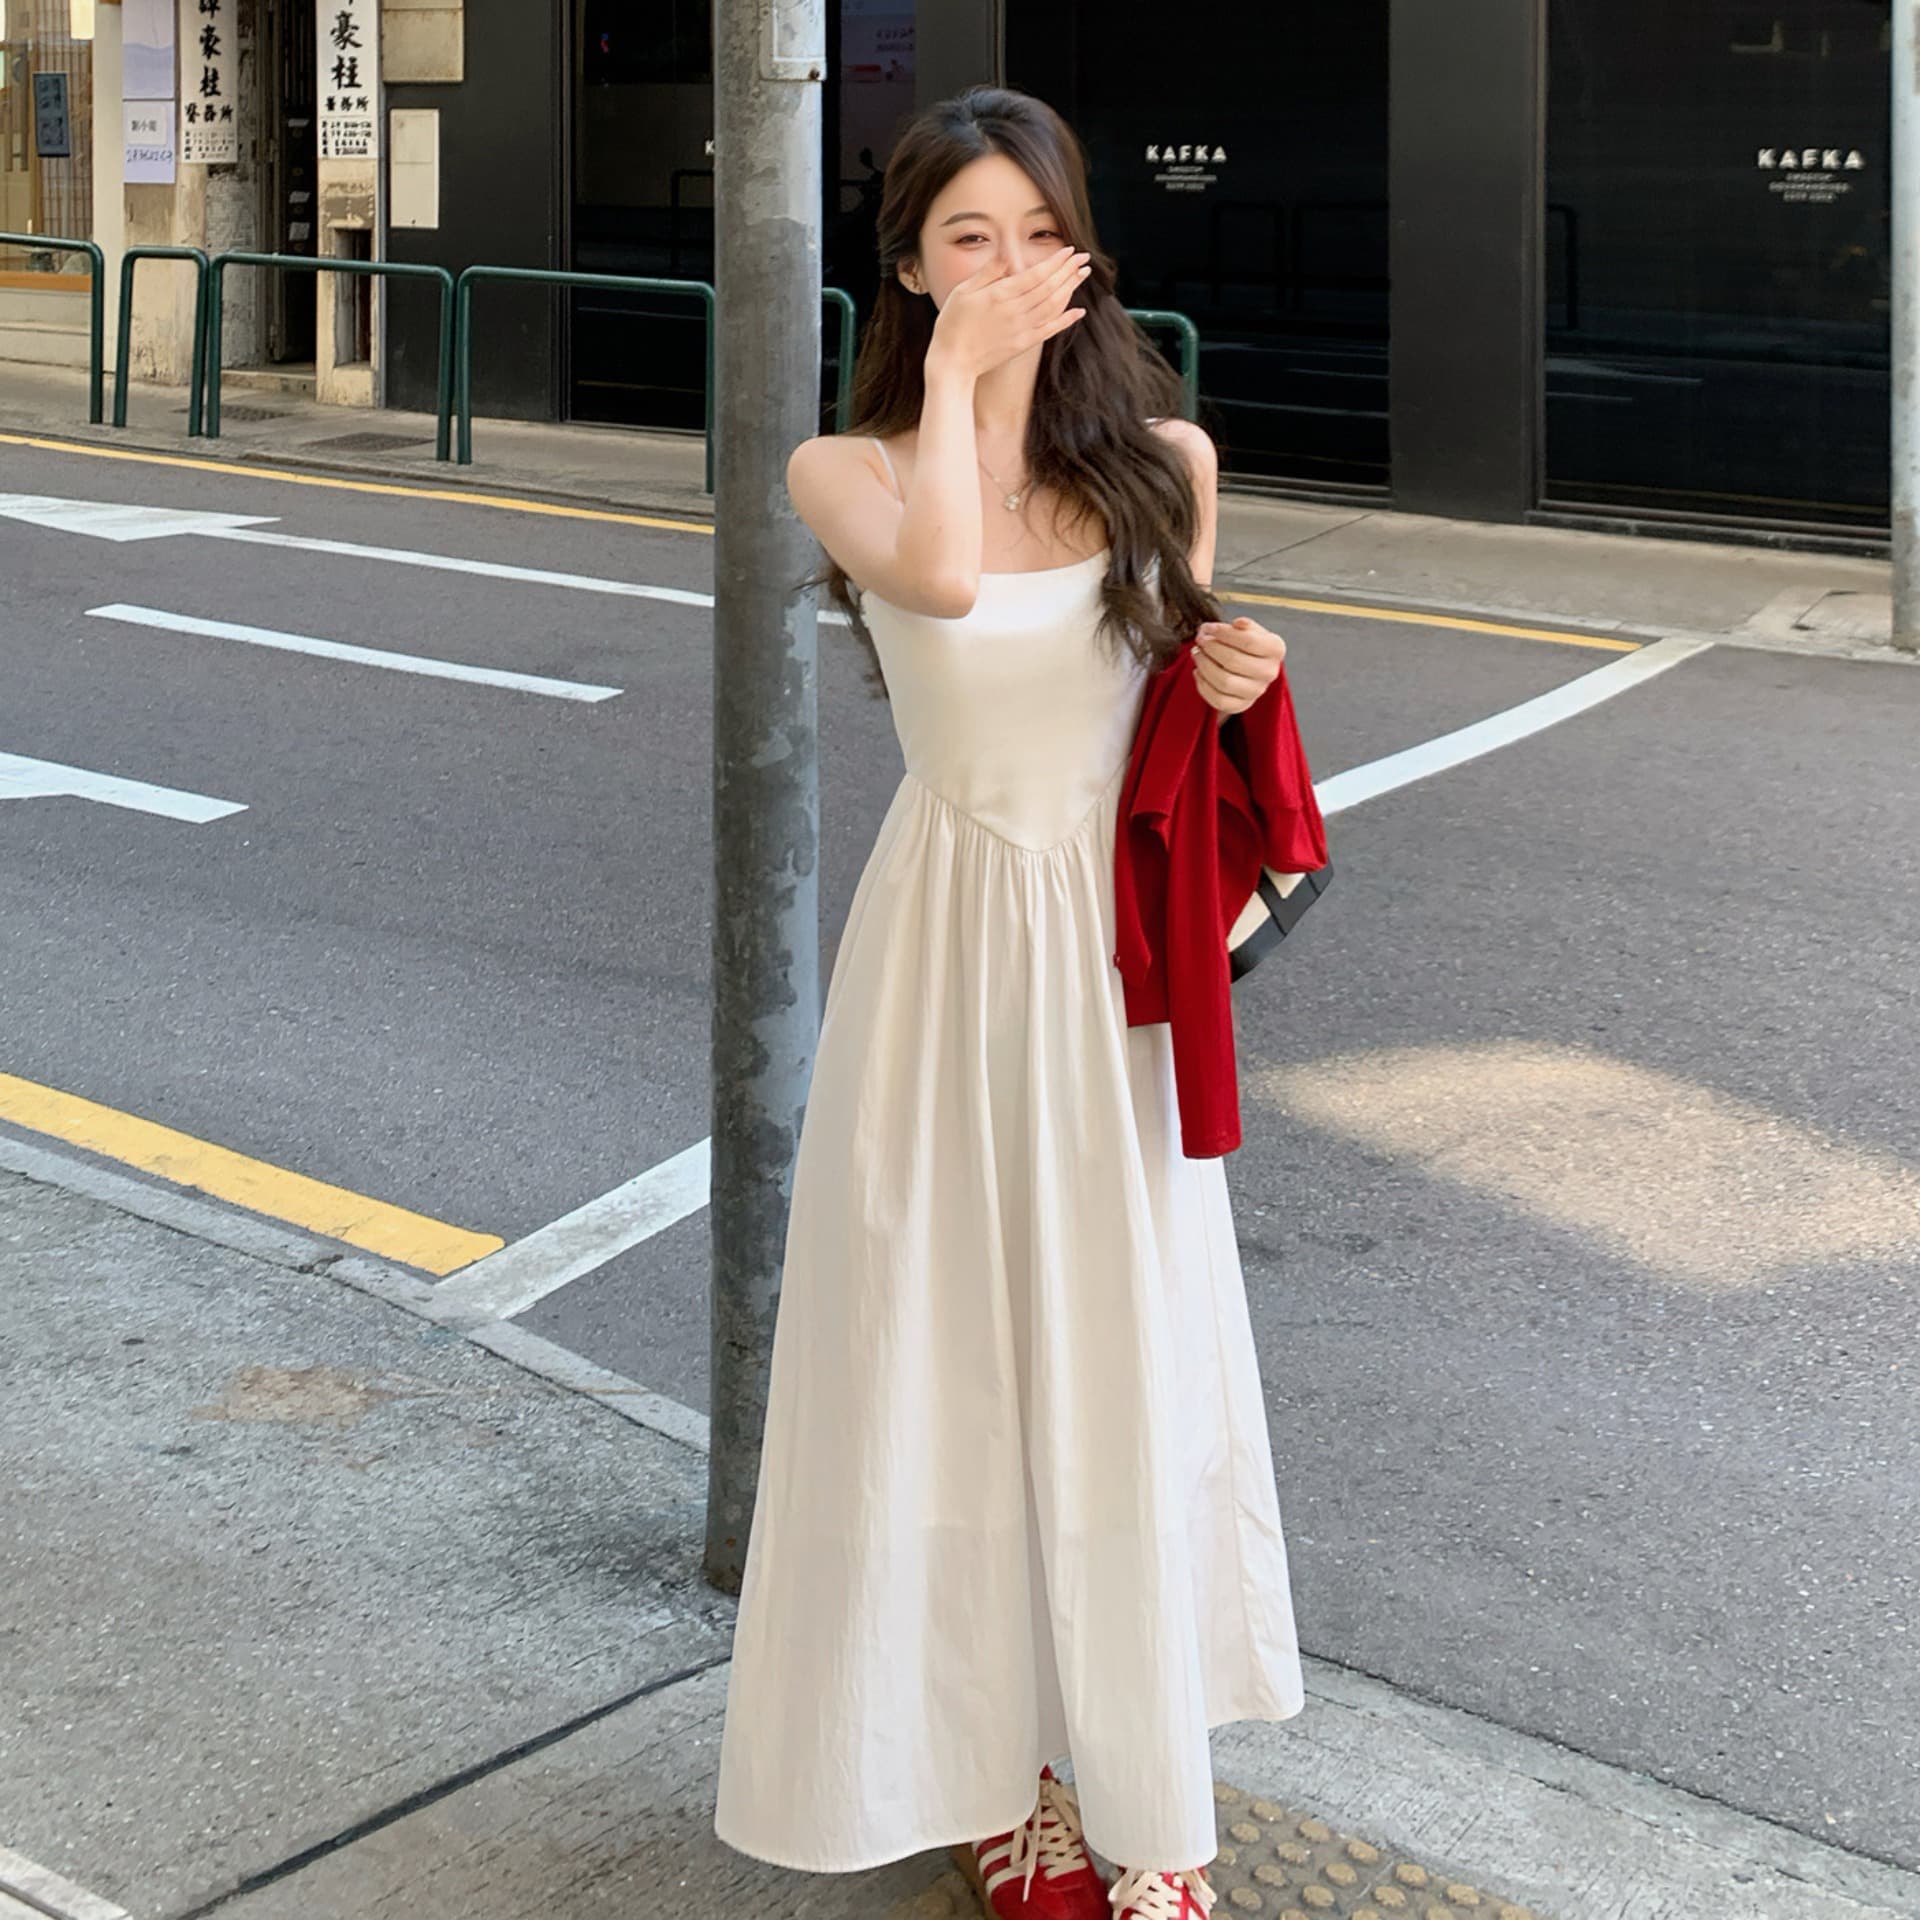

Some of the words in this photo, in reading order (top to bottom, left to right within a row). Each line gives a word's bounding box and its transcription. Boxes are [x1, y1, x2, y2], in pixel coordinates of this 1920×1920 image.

[330, 0, 363, 90] 豪柱
[1145, 144, 1227, 161] KAFKA
[1758, 148, 1864, 169] KAFKA
